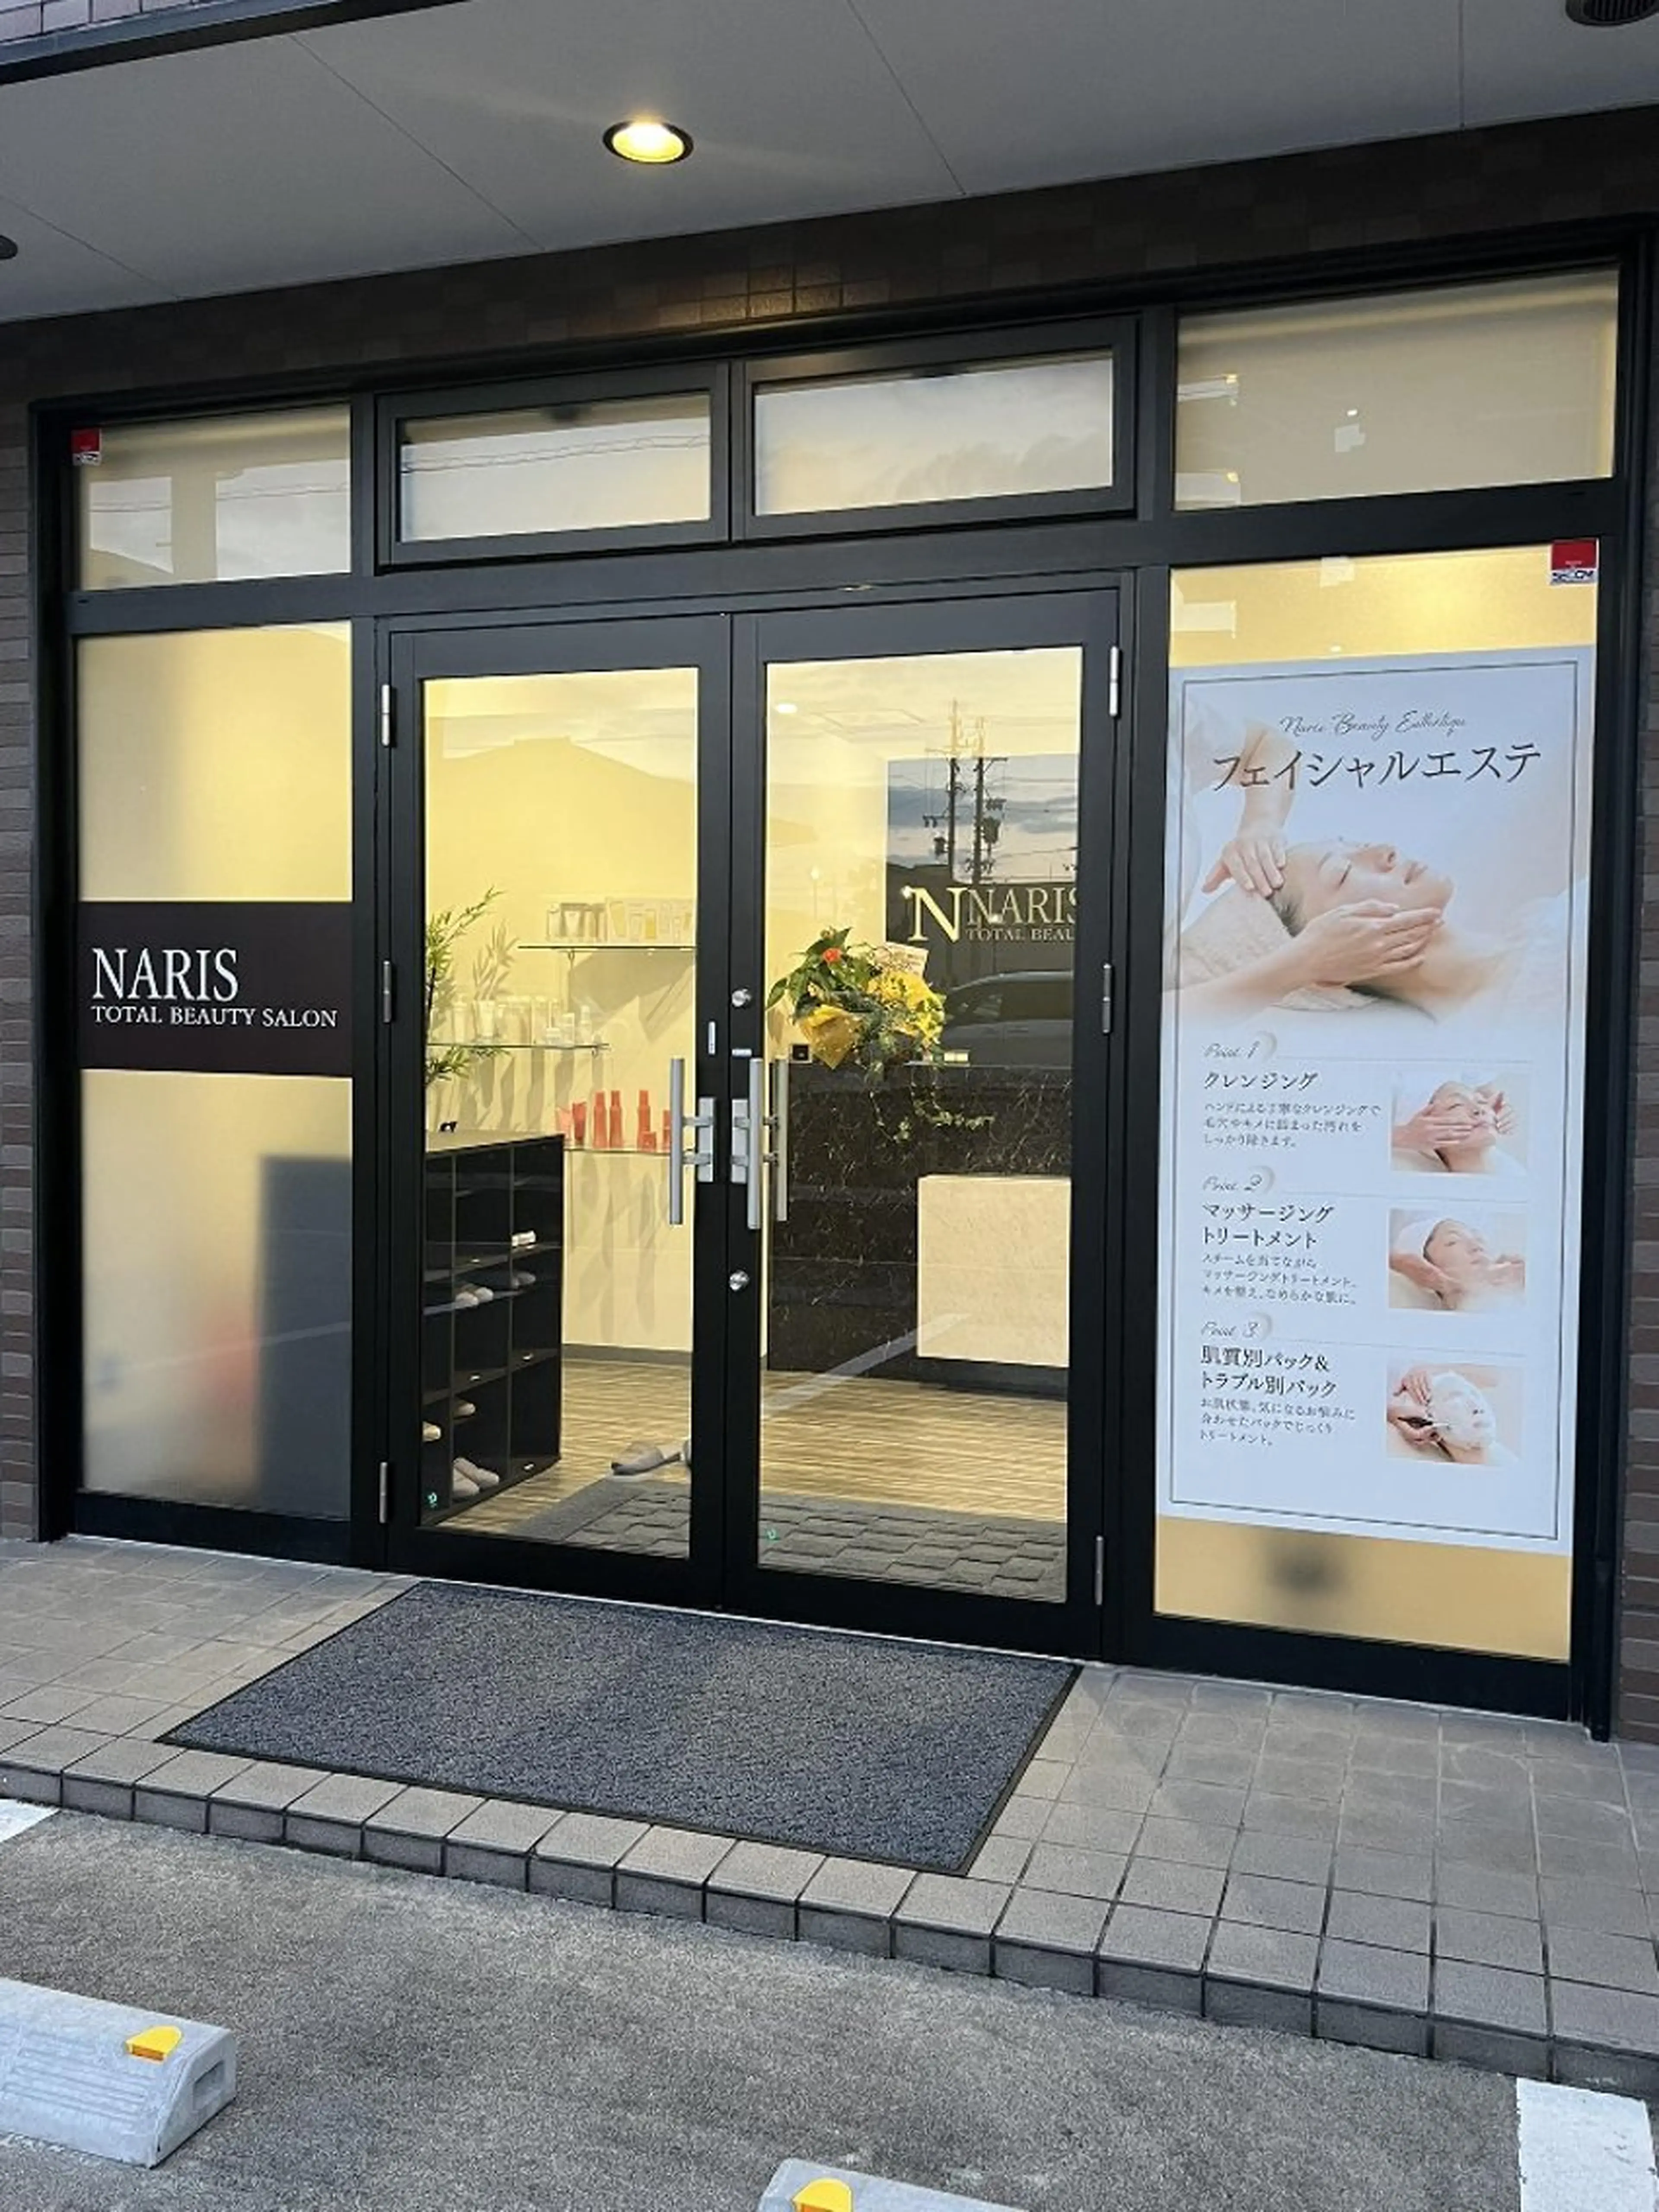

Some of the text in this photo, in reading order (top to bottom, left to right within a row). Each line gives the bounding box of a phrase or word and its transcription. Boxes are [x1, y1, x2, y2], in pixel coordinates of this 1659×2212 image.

[1213, 743, 1541, 791] フェイシャルエステ
[908, 887, 968, 943] N
[966, 928, 1025, 941] TOTAL
[92, 947, 238, 1002] NARIS
[90, 1006, 338, 1027] TOTAL BEAUTY SALON
[1204, 1072, 1319, 1091] クレンジング
[1244, 1174, 1262, 1191] 2
[1202, 1202, 1335, 1224] マッサージング
[1204, 1227, 1317, 1249] トリートメント
[1243, 1322, 1259, 1338] 3
[1202, 1371, 1337, 1399] トラブル別パック
